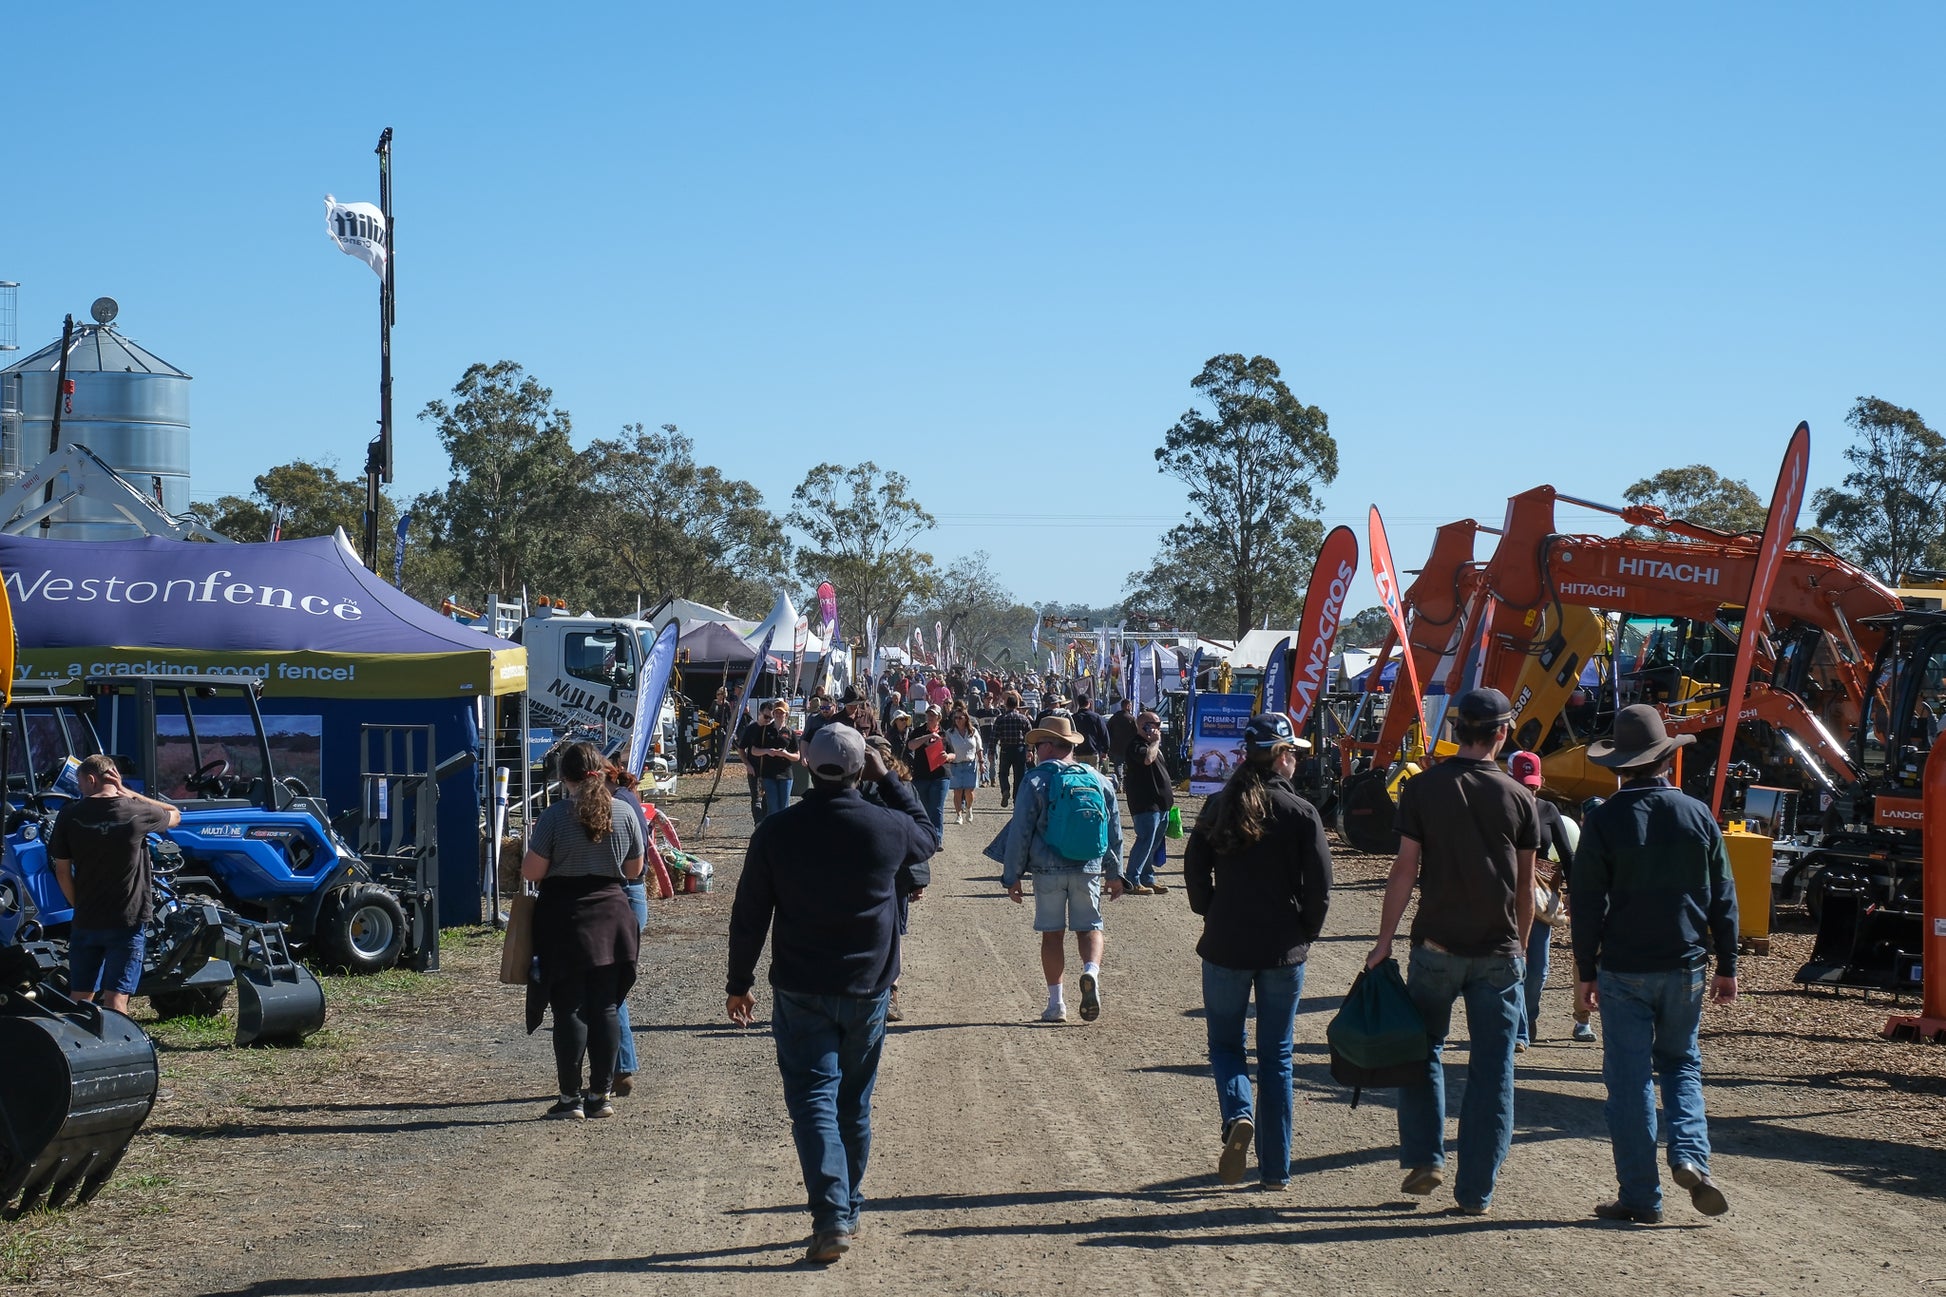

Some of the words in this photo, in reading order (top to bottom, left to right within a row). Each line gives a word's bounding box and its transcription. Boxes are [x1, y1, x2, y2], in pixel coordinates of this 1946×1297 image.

[1618, 557, 1720, 586] HITACHI
[1560, 582, 1626, 598] HITACHI
[1289, 560, 1354, 724] LANDCROS
[67, 663, 82, 676] a
[90, 660, 199, 676] cracking
[277, 662, 355, 681] fence!
[1264, 662, 1279, 714] ATSU
[547, 677, 635, 730] MILLARD
[1715, 708, 1758, 724] HCHI
[1882, 809, 1924, 820] LANDCR
